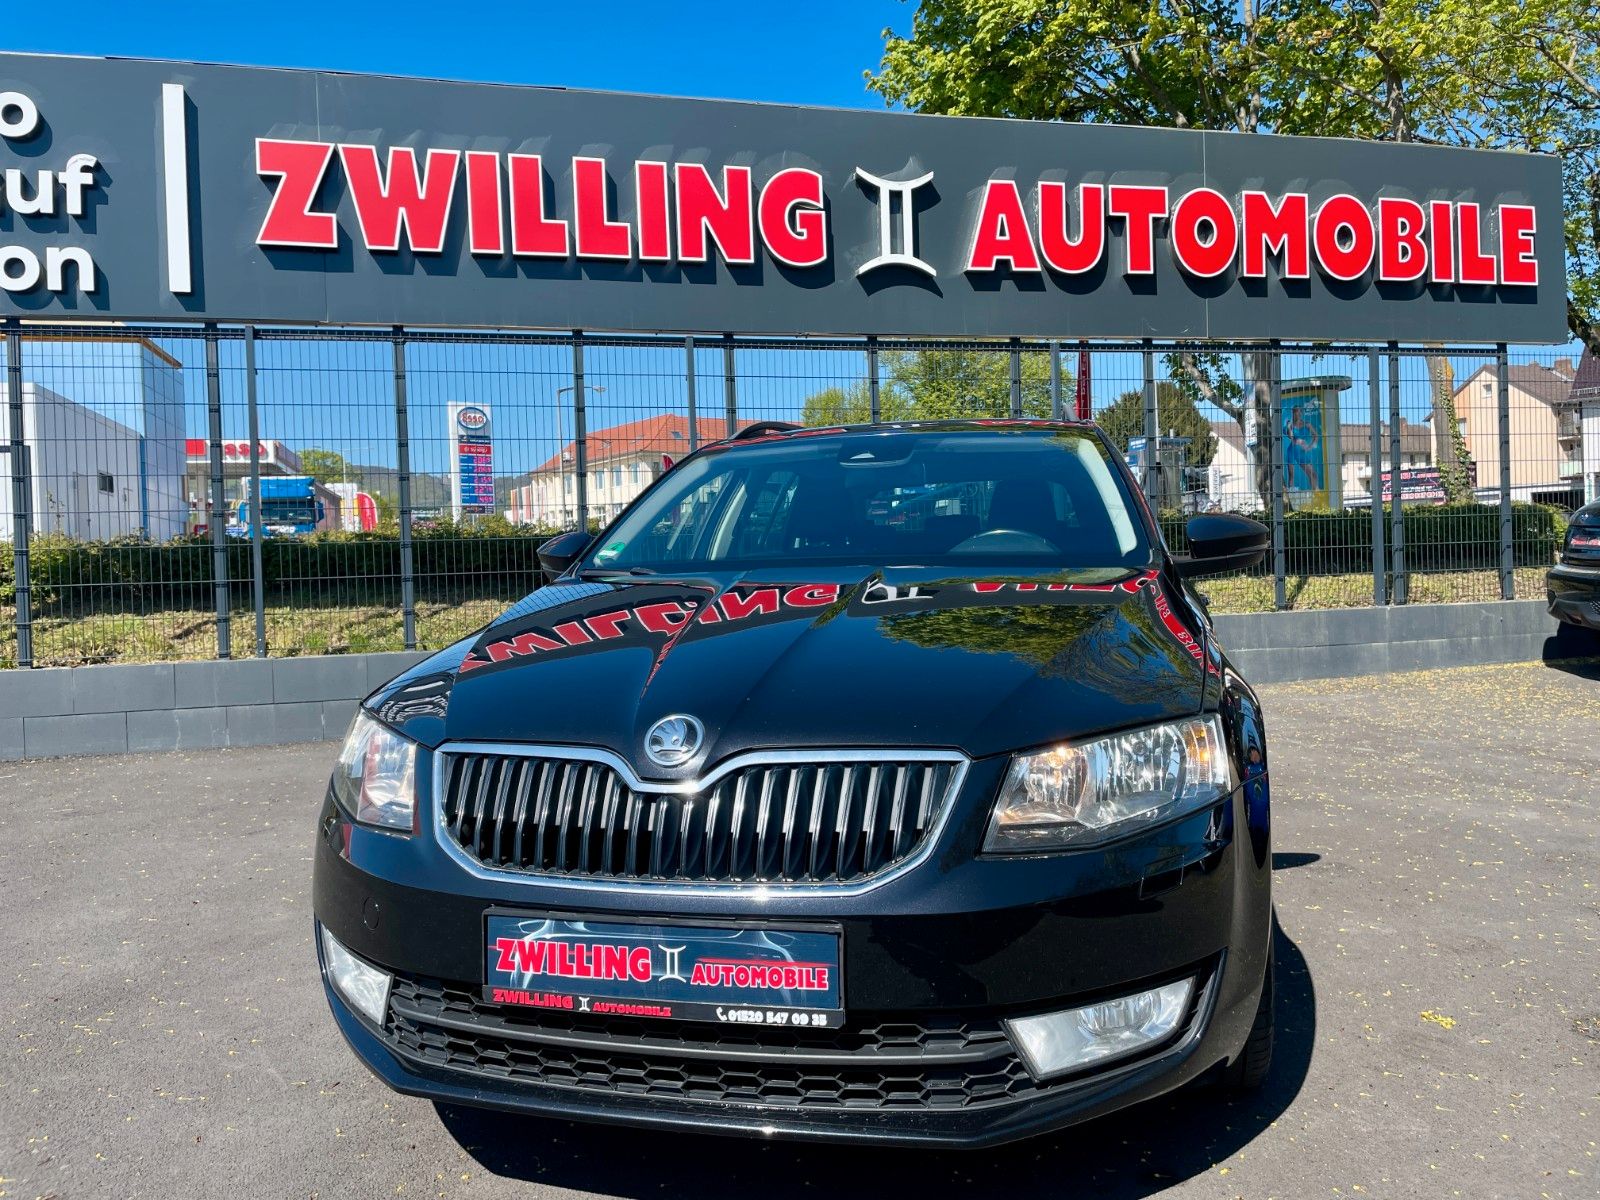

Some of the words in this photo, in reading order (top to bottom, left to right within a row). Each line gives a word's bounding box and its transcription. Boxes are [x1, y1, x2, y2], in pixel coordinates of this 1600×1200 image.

[255, 137, 828, 269] ZWILLING
[966, 179, 1539, 287] AUTOMOBILE
[496, 937, 652, 981] ZWILLING
[690, 963, 829, 991] AUTOMOBILE
[492, 988, 574, 1010] ZWILLING
[592, 1001, 672, 1018] AUTOMOBILE
